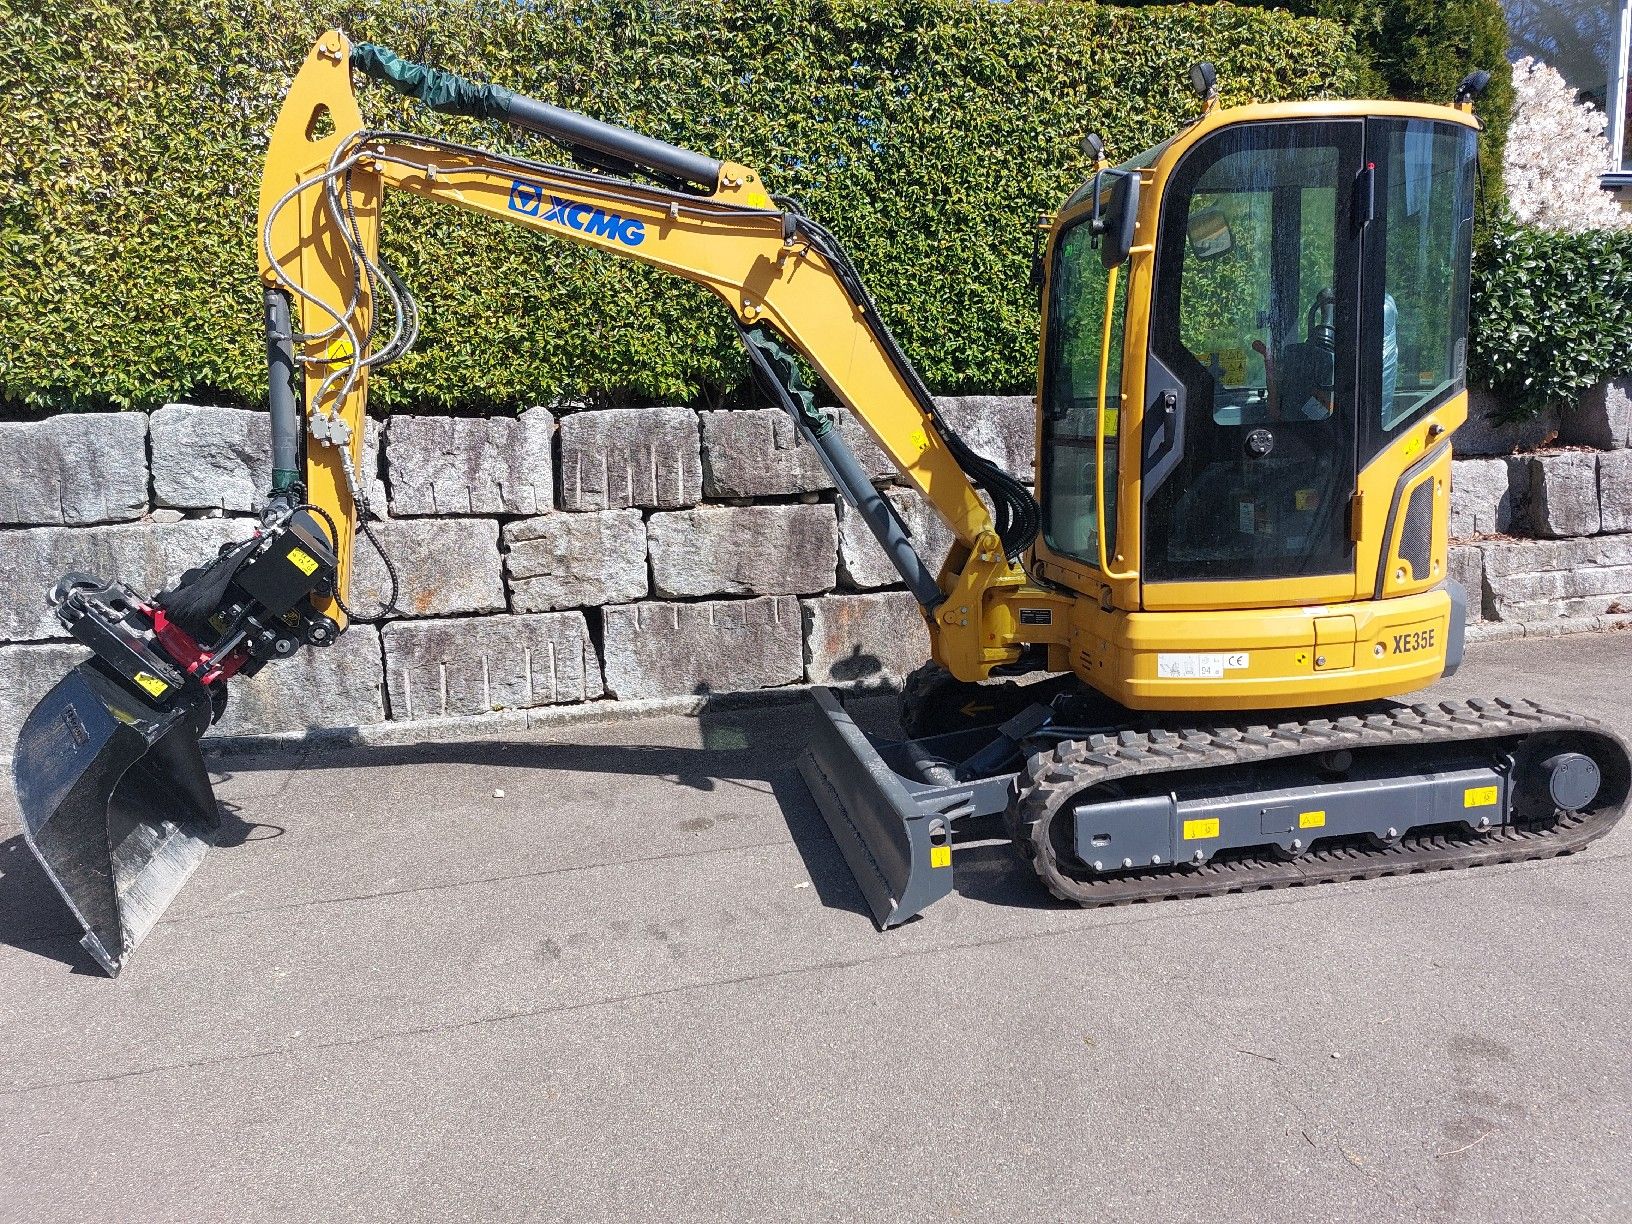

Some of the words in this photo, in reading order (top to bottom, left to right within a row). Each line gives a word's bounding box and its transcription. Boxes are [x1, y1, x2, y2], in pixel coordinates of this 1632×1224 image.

[539, 195, 645, 246] XCMG
[1393, 629, 1434, 654] XE35E
[1228, 655, 1243, 666] CE
